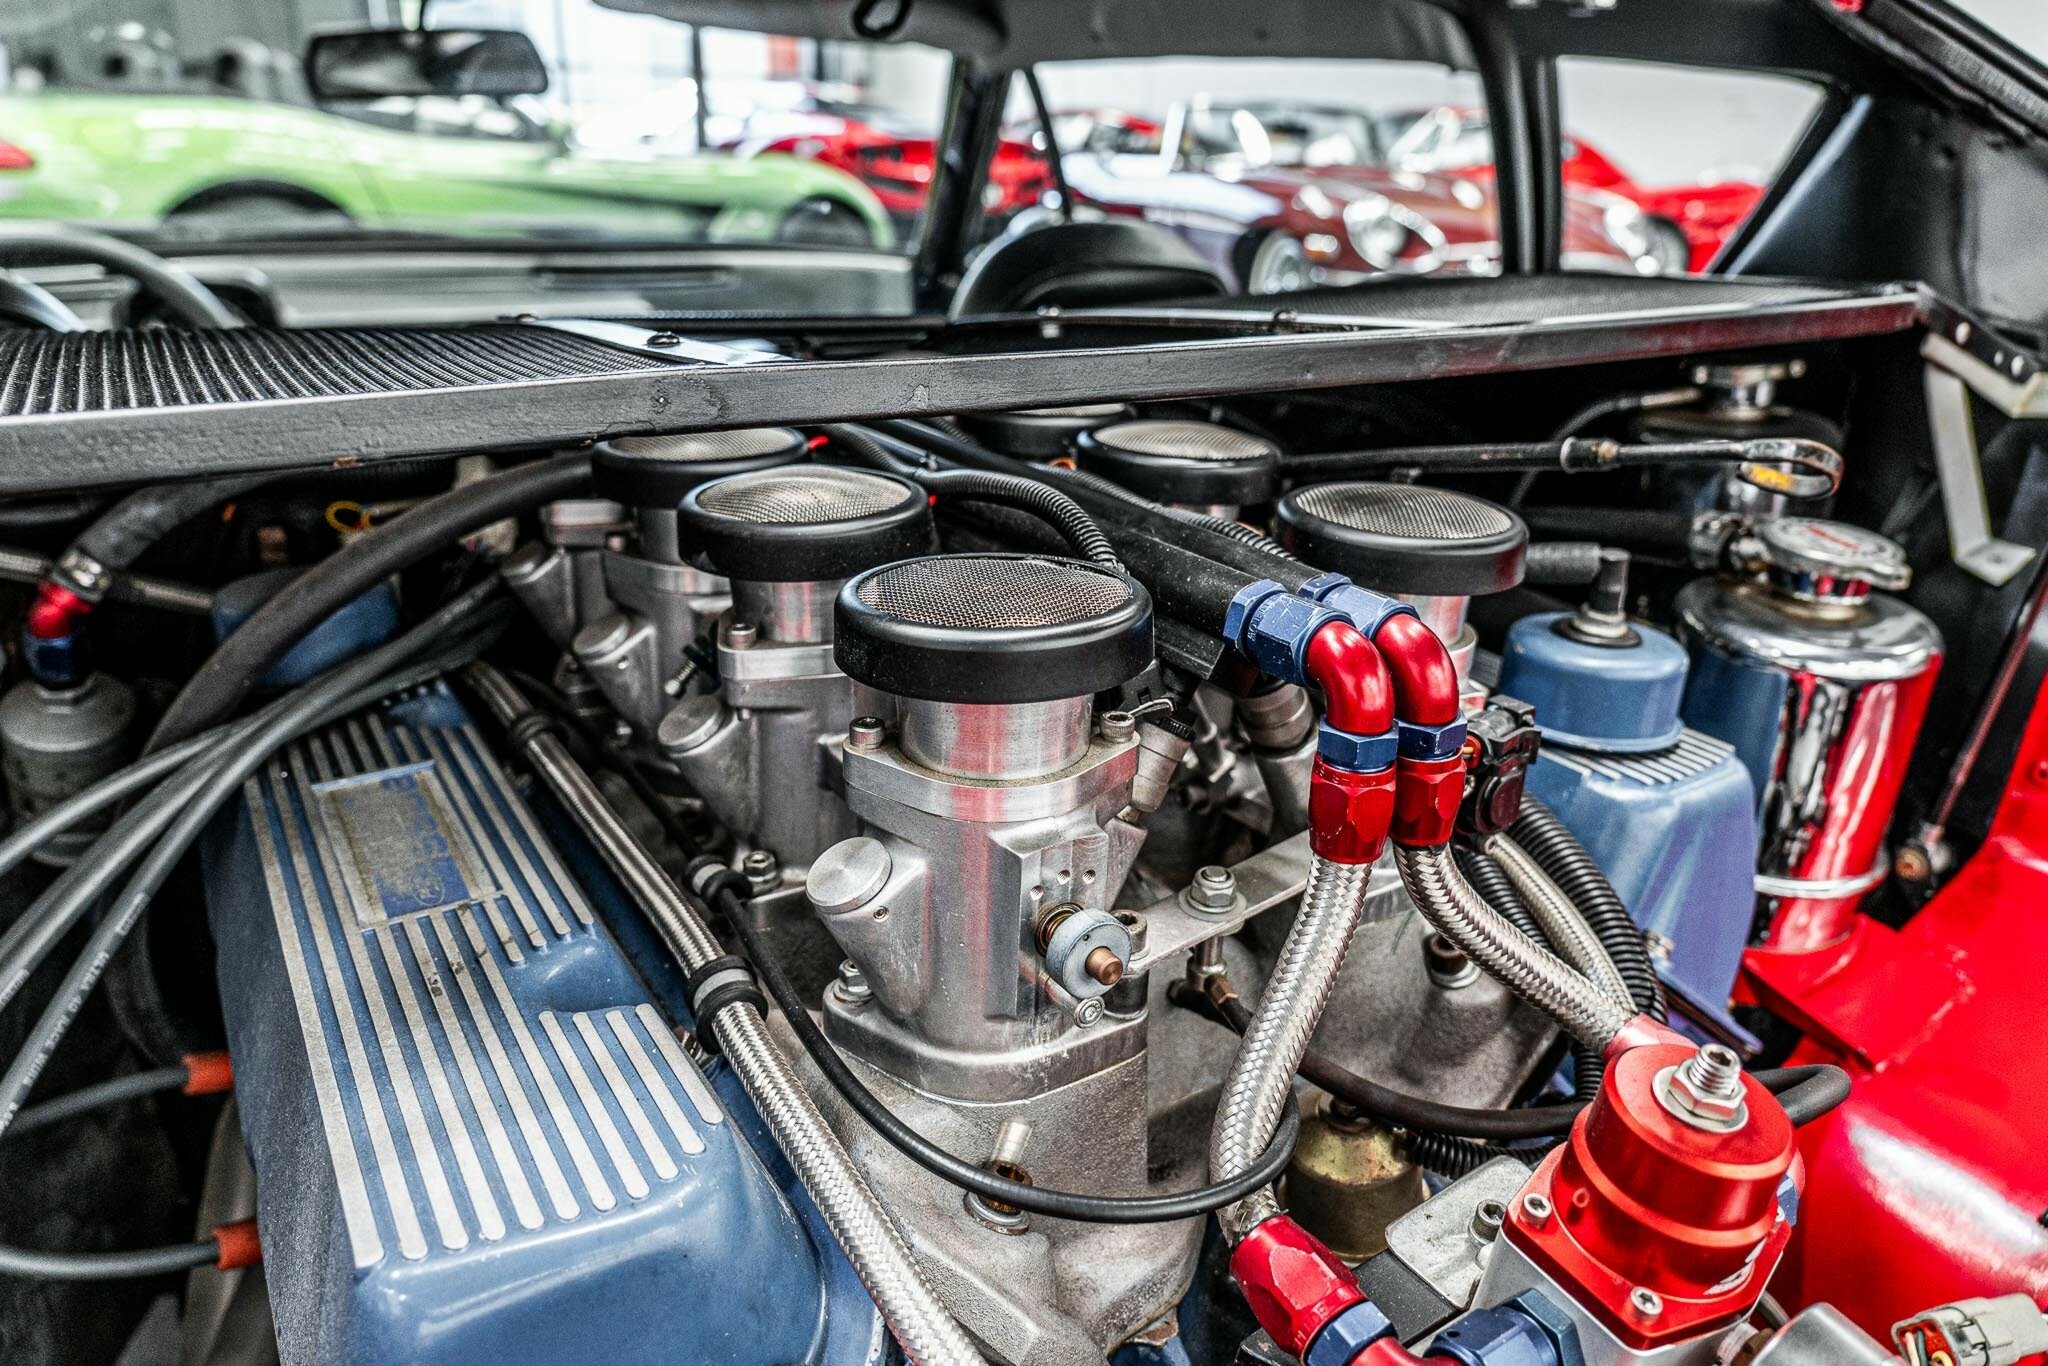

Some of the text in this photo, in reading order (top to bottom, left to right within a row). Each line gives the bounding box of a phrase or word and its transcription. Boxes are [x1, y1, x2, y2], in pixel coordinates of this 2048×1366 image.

[80, 951, 110, 991] ULTRA
[44, 1014, 71, 1050] RACE
[22, 1052, 48, 1087] WIRE
